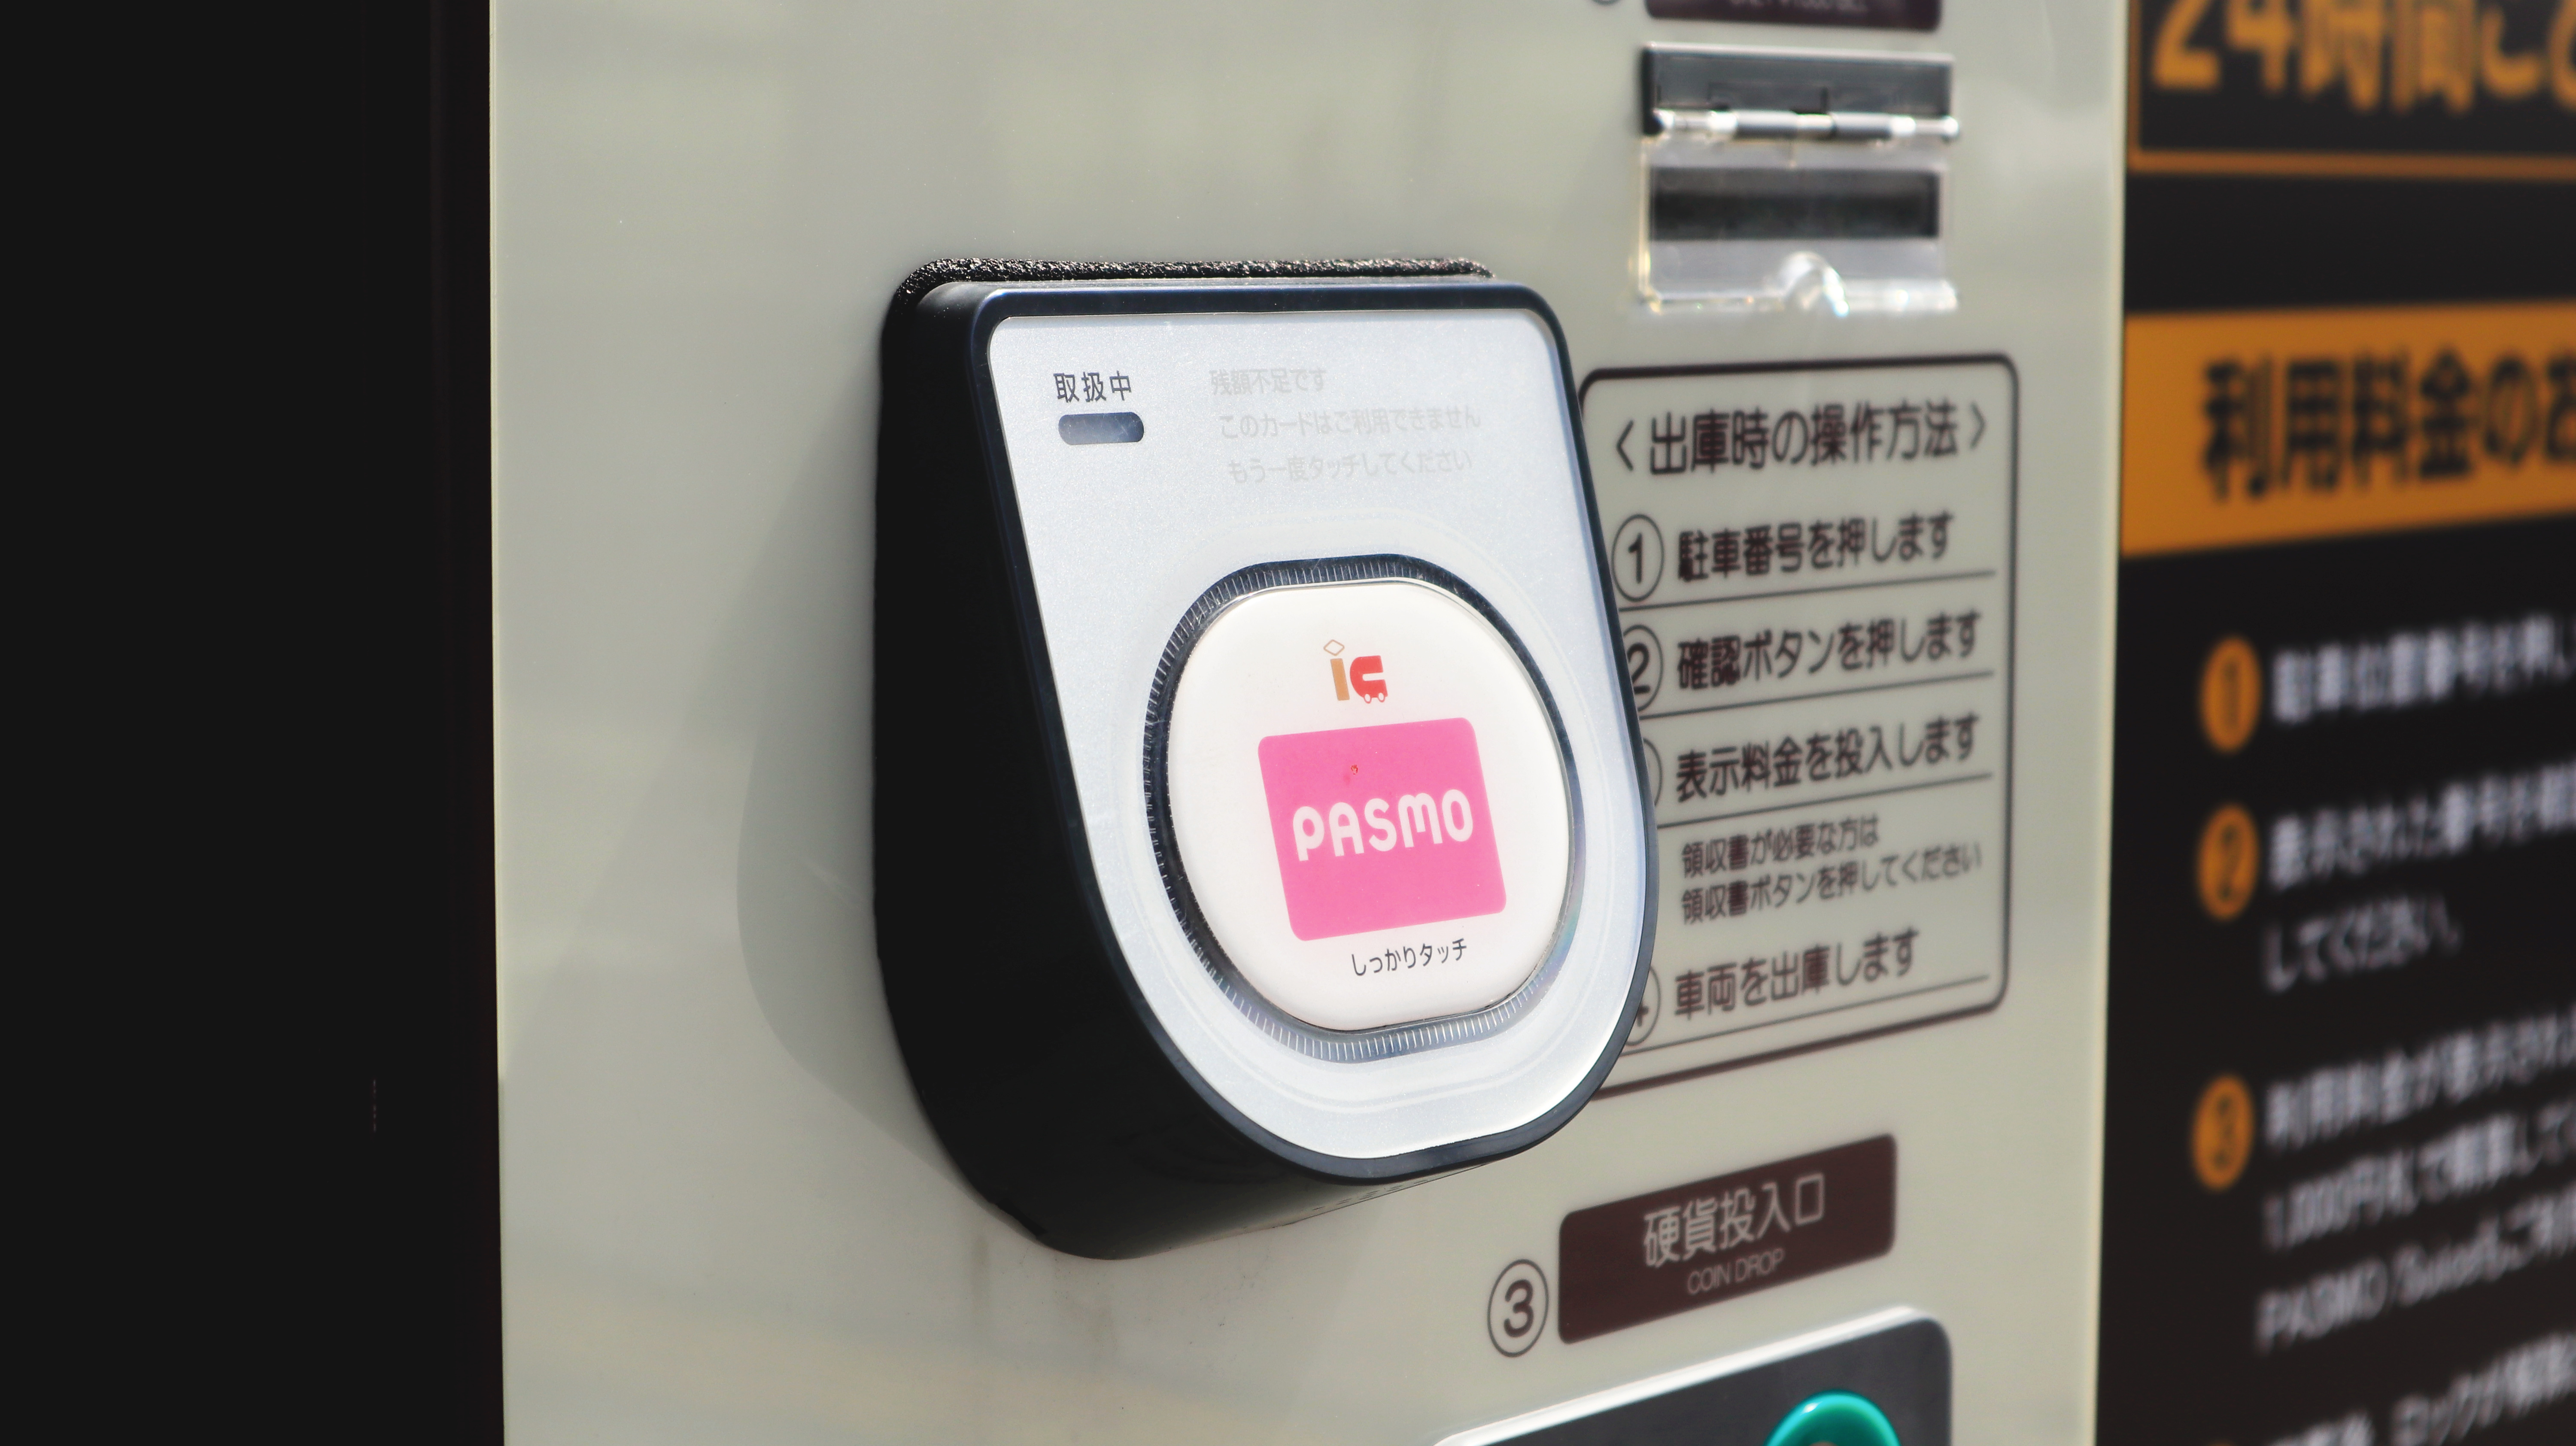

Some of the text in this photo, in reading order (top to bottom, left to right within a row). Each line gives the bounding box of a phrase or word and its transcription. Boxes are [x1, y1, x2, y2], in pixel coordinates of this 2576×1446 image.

[1053, 371, 1133, 404] 取扱中
[1209, 367, 1327, 396] 残額不足です
[1219, 405, 1482, 439] このカードはご利用できません
[1228, 450, 1473, 484] もう一度タッチしてください
[1677, 510, 1954, 582] 駐車番号を押します
[1677, 610, 1981, 690] 確認ボタンを押します
[1676, 714, 1980, 804] 表示料金を投入します
[1292, 788, 1474, 862] PASMO
[1682, 813, 1881, 879] 領収書が必要な方は
[1682, 841, 1983, 925] 領収書ボタンを押してください
[1351, 938, 1468, 977] しっかりタッチ
[1674, 926, 1920, 1019] 車両を出庫します
[1642, 1173, 1826, 1268] 硬貨投入口
[1687, 1248, 1785, 1295] COIN DROP
